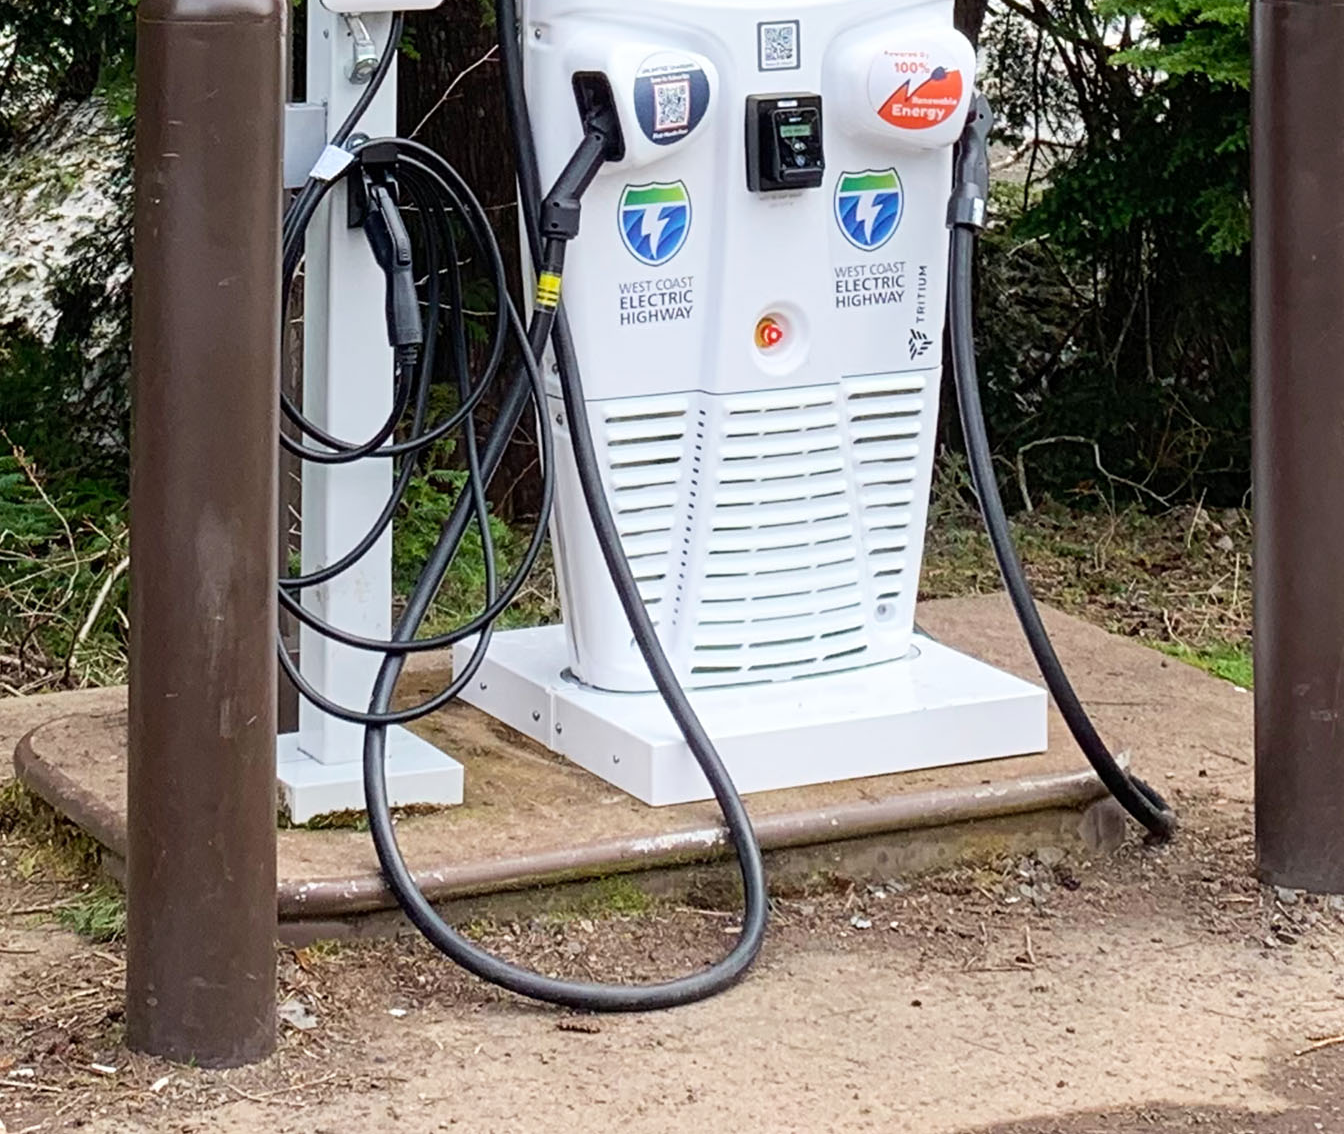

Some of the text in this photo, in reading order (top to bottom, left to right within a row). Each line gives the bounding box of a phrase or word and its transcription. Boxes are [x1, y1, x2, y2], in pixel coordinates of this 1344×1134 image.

[894, 60, 931, 74] 100%
[891, 103, 945, 121] Energy
[834, 261, 906, 278] WEST COAST
[618, 275, 694, 295] WEST COAST
[835, 274, 906, 294] ELECTRIC
[620, 289, 694, 310] ELECTRIC
[835, 289, 906, 309] HIGHWAY
[915, 265, 928, 324] TRITIUM
[620, 305, 693, 326] HIGHWAY
